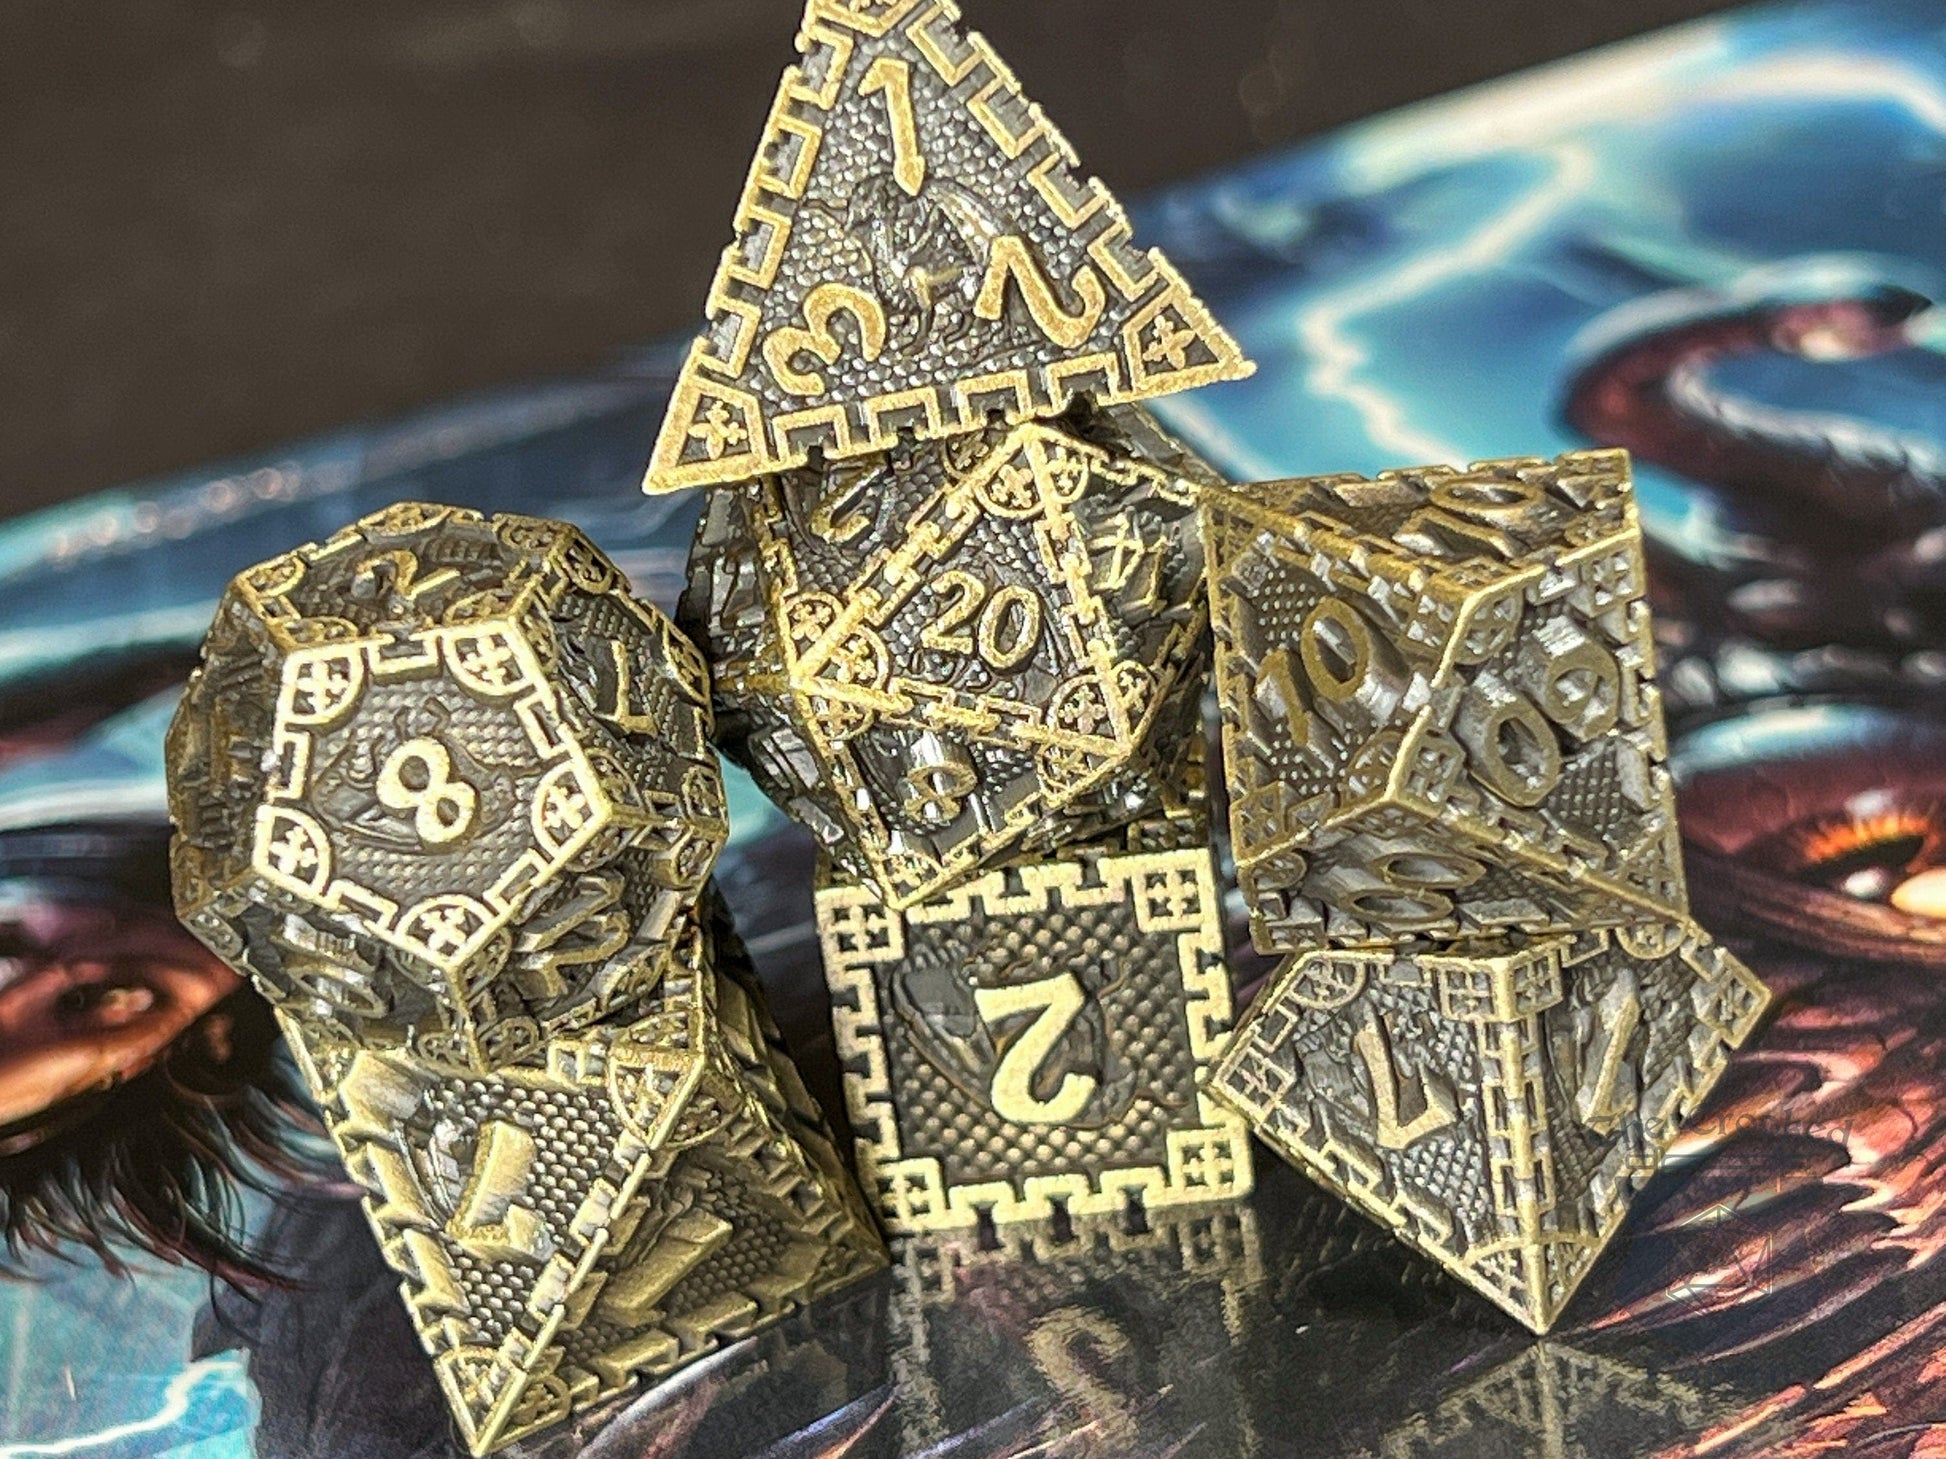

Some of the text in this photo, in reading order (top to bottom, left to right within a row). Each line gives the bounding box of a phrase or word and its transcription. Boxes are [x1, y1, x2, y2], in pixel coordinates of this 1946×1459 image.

[859, 58, 927, 197] 1
[762, 283, 886, 396] 3
[975, 235, 1107, 349] 2
[921, 569, 1042, 669] 20
[1255, 596, 1371, 749] 10
[377, 736, 477, 844] 8
[973, 971, 1096, 1124] 2
